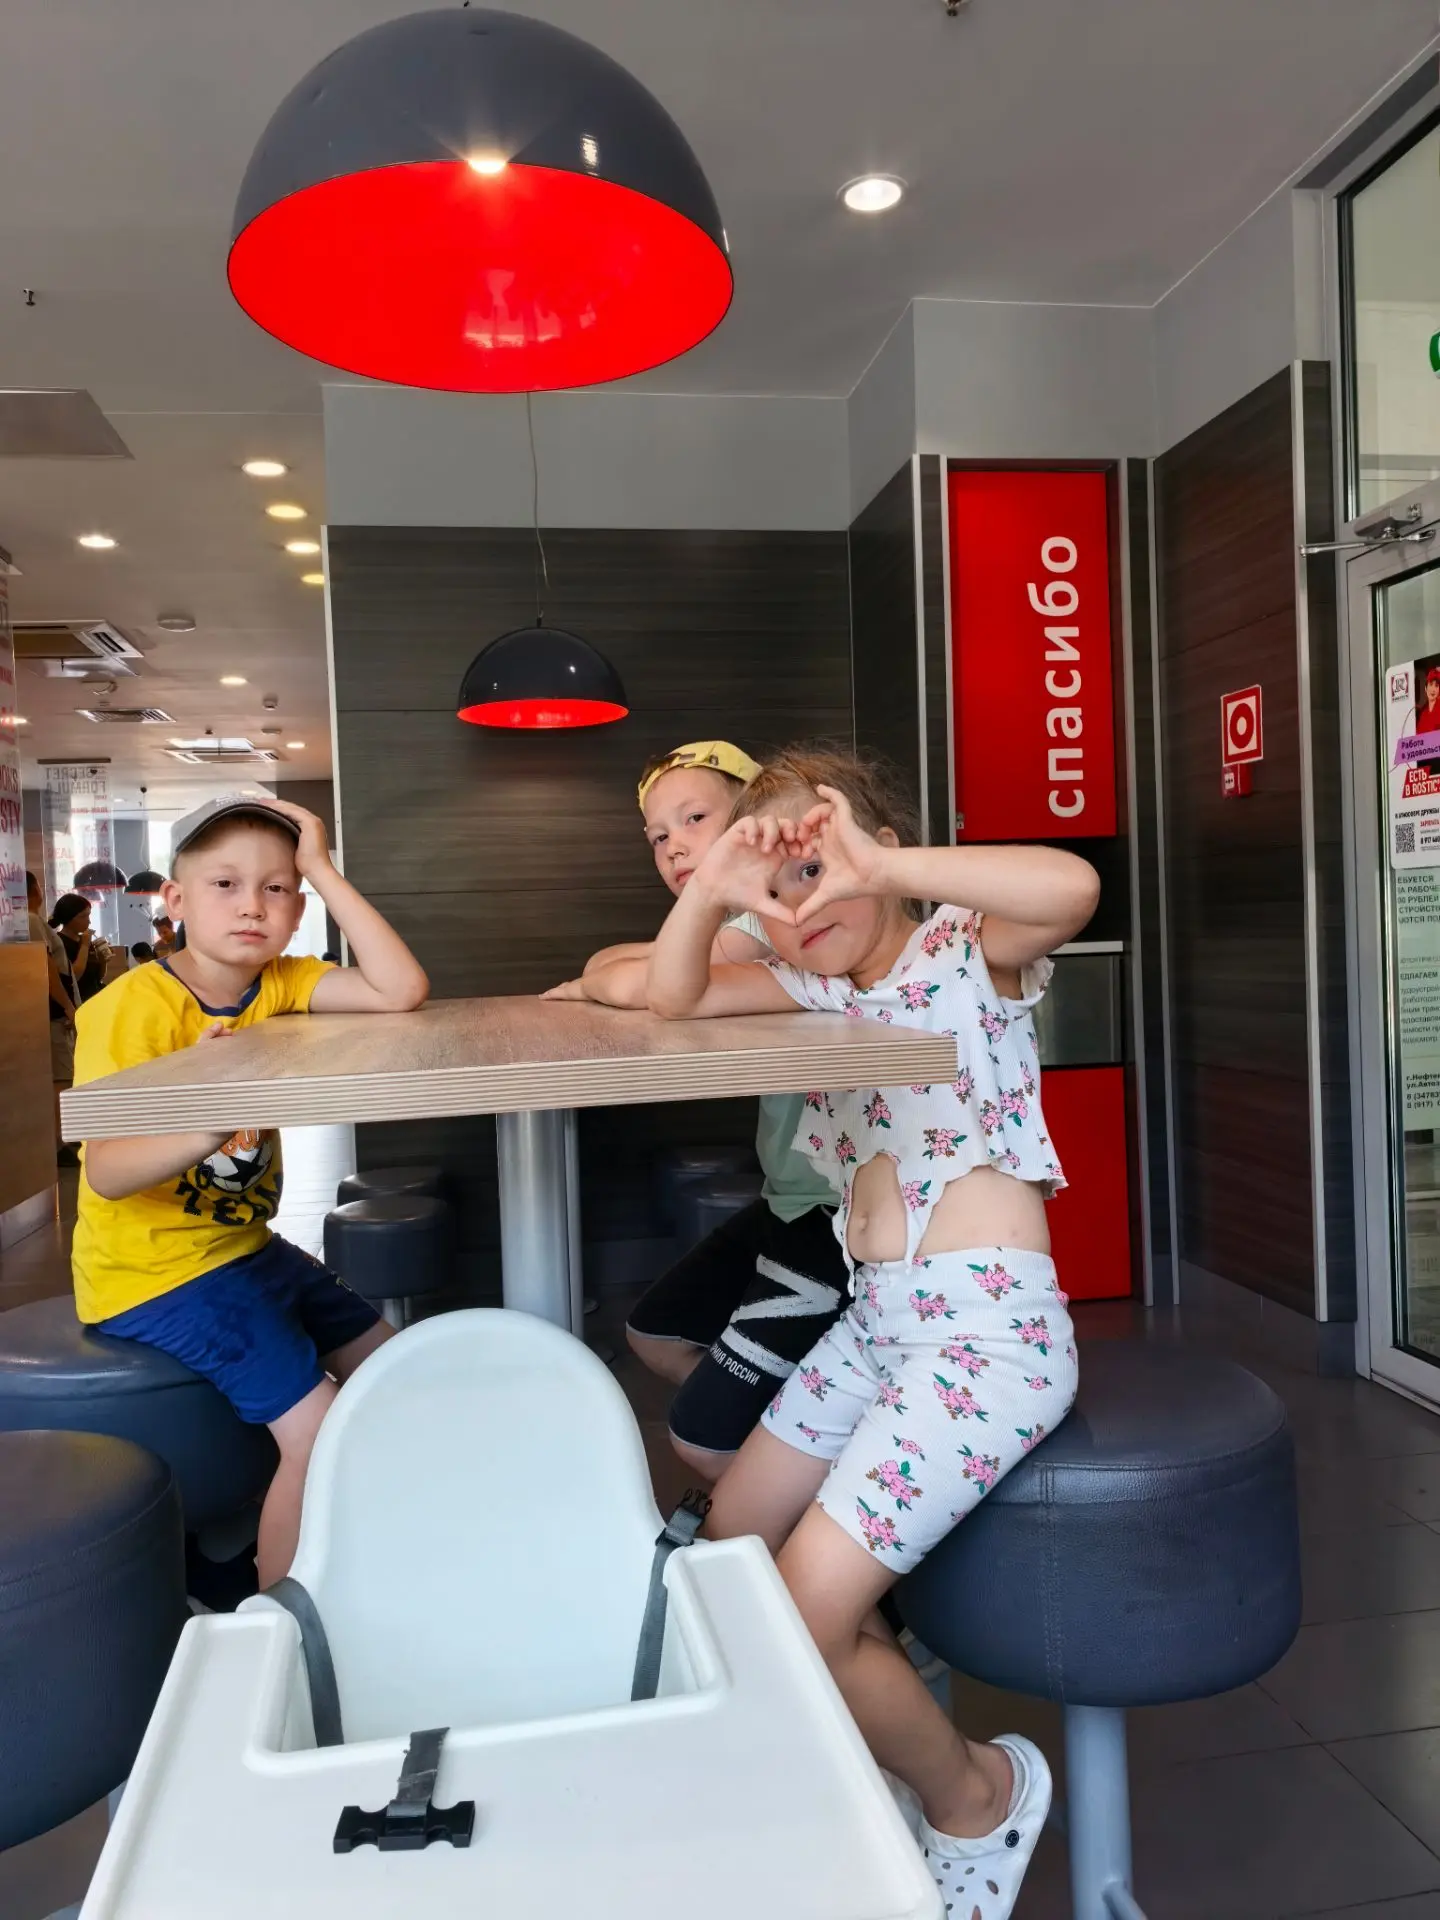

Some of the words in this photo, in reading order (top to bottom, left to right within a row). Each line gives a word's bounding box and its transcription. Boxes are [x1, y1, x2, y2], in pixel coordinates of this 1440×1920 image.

[1026, 535, 1085, 818] спасибо
[1401, 739, 1424, 749] Работа
[1409, 769, 1427, 783] ЕСТЬ
[722, 1356, 761, 1386] РОССИИ
